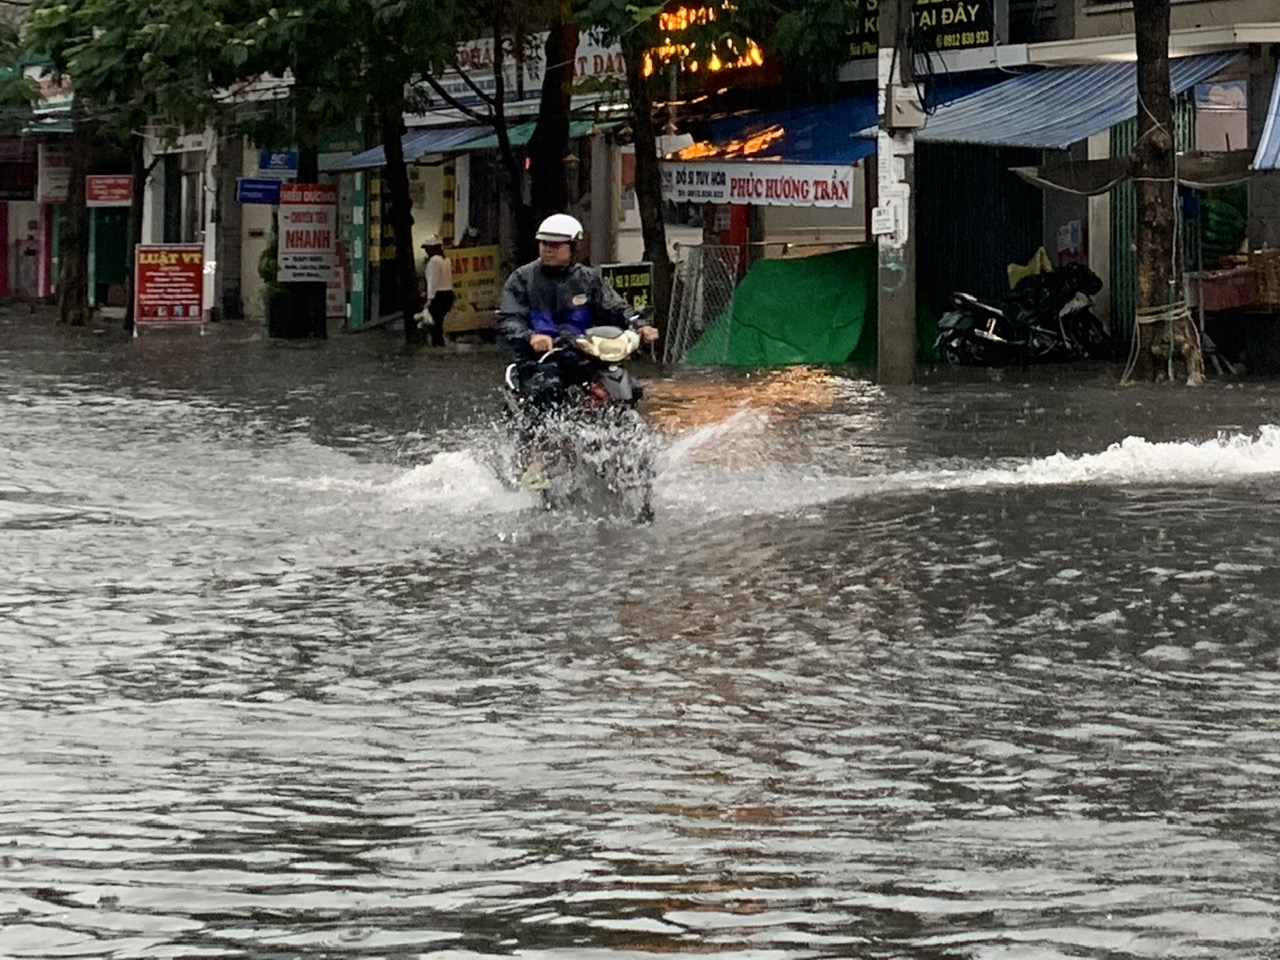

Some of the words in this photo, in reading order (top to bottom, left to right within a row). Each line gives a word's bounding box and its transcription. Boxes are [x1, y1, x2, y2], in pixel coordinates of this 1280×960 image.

[941, 2, 980, 25] ĐÂY
[943, 35, 960, 48] 0912
[961, 32, 975, 45] 830
[976, 30, 989, 44] 923
[730, 172, 763, 199] PHÚC
[765, 176, 809, 200] HƯƠNG
[285, 230, 331, 248] NHANH
